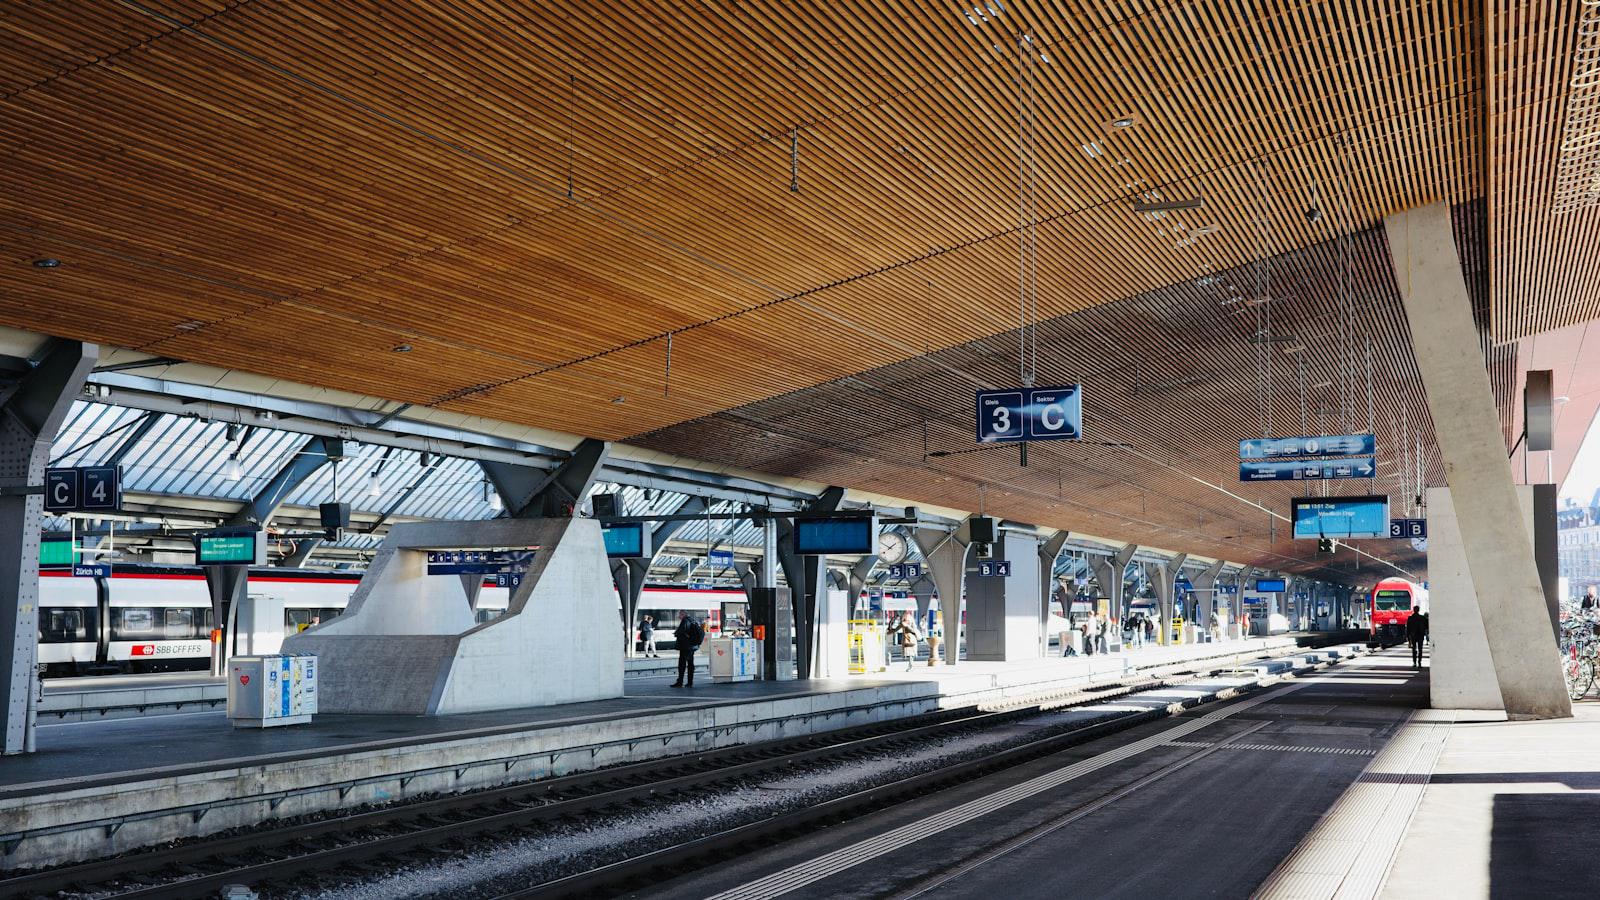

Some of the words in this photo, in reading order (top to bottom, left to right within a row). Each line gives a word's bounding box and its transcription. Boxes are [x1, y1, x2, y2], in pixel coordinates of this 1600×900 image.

[992, 406, 1011, 433] 3
[1041, 403, 1065, 431] C
[54, 482, 69, 503] C
[92, 480, 106, 502] 4
[1392, 525, 1400, 535] 3
[1412, 525, 1421, 535] B
[76, 567, 93, 576] Zürich
[94, 568, 103, 576] HB
[893, 568, 900, 577] 5
[909, 567, 916, 576] B
[983, 566, 990, 574] B
[999, 566, 1006, 574] 4
[499, 577, 506, 585] B
[512, 577, 519, 585] 6
[156, 645, 171, 654] SBB
[172, 645, 187, 654] CFF
[188, 644, 202, 653] FFS
